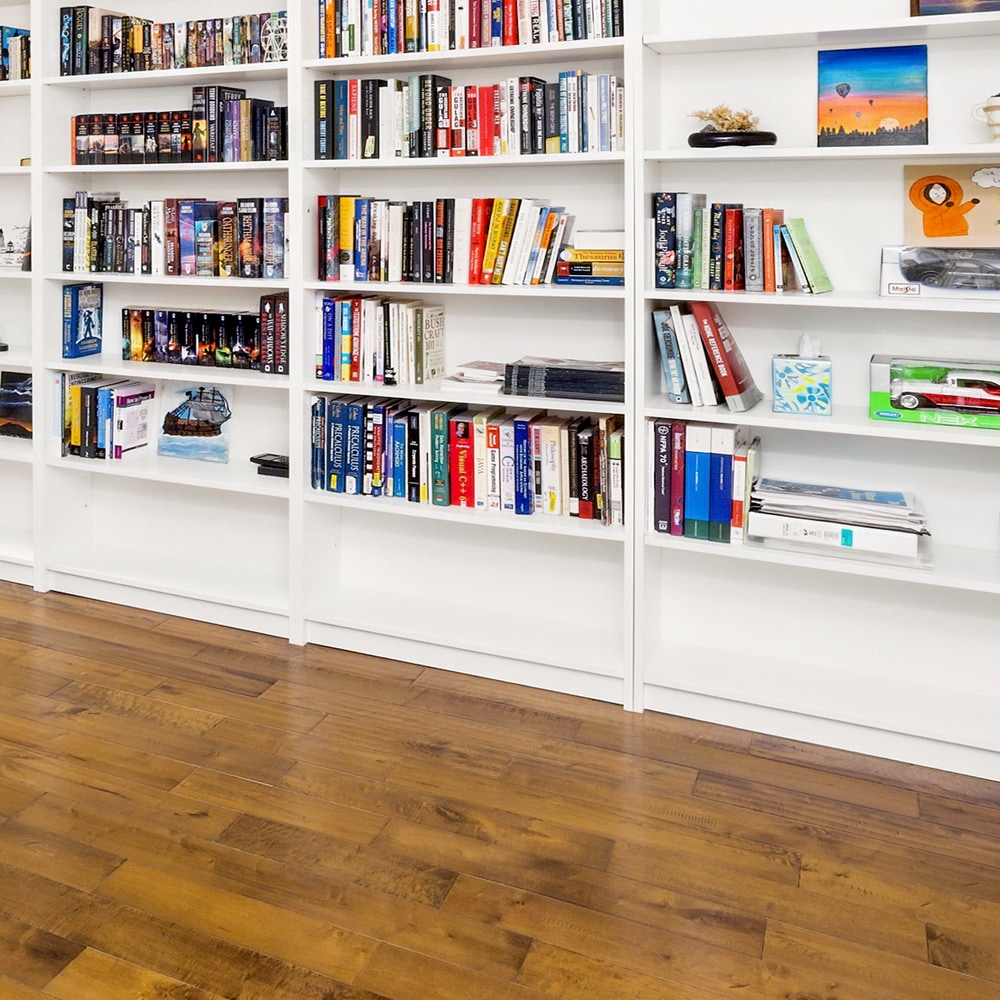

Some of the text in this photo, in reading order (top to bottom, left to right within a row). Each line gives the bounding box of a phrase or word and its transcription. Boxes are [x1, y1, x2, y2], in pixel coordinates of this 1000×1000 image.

[76, 8, 84, 31] ROGUES
[532, 18, 540, 40] REAL
[424, 79, 432, 130] BEYOND ORDER
[242, 214, 253, 242] RHYTHM
[713, 212, 722, 227] Matt
[222, 217, 234, 263] OATHBRINGER
[682, 236, 690, 276] DAVID GRANN
[891, 286, 917, 294] Maisto
[424, 316, 444, 328] BUSH
[424, 327, 444, 340] CRAFT
[660, 322, 671, 332] JOE
[266, 335, 274, 364] SHADOWS
[425, 340, 435, 351] 101
[702, 324, 713, 338] HOME
[708, 338, 723, 365] REFERENCE
[717, 364, 728, 378] BOOK
[333, 423, 343, 468] PRECALCULUS
[350, 425, 360, 471] PRECALCULUS
[549, 440, 557, 473] Philosophy
[659, 435, 667, 454] NFPA
[458, 449, 468, 474] Visual
[476, 457, 484, 475] JAVA
[459, 475, 467, 494] C++
[581, 456, 589, 501] ARCHAEOLOGY
